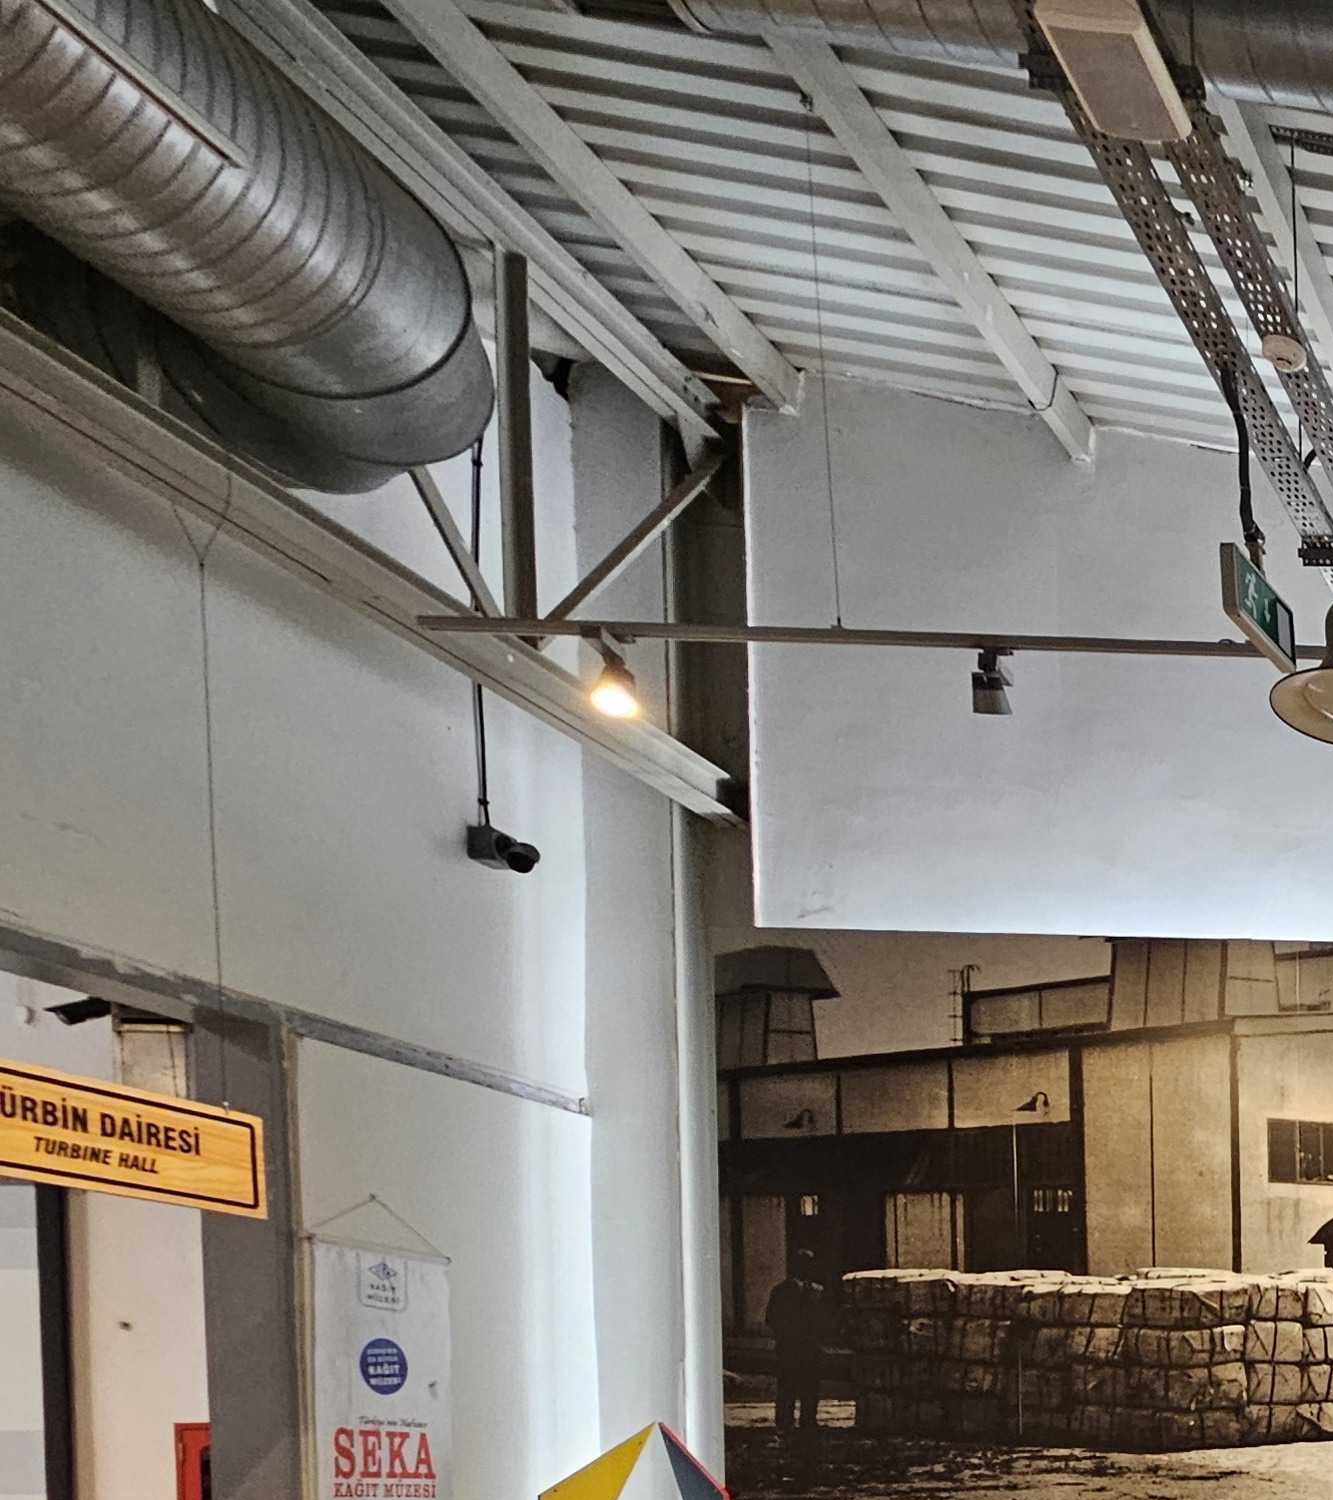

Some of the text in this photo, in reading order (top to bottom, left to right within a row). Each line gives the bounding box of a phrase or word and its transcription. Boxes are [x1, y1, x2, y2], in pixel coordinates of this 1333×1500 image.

[100, 1112, 201, 1156] DAİRESİ
[33, 1136, 159, 1174] TURBINE HALL
[334, 1427, 436, 1479] SEKA
[333, 1479, 436, 1498] KAĞIT MÜZESİ
